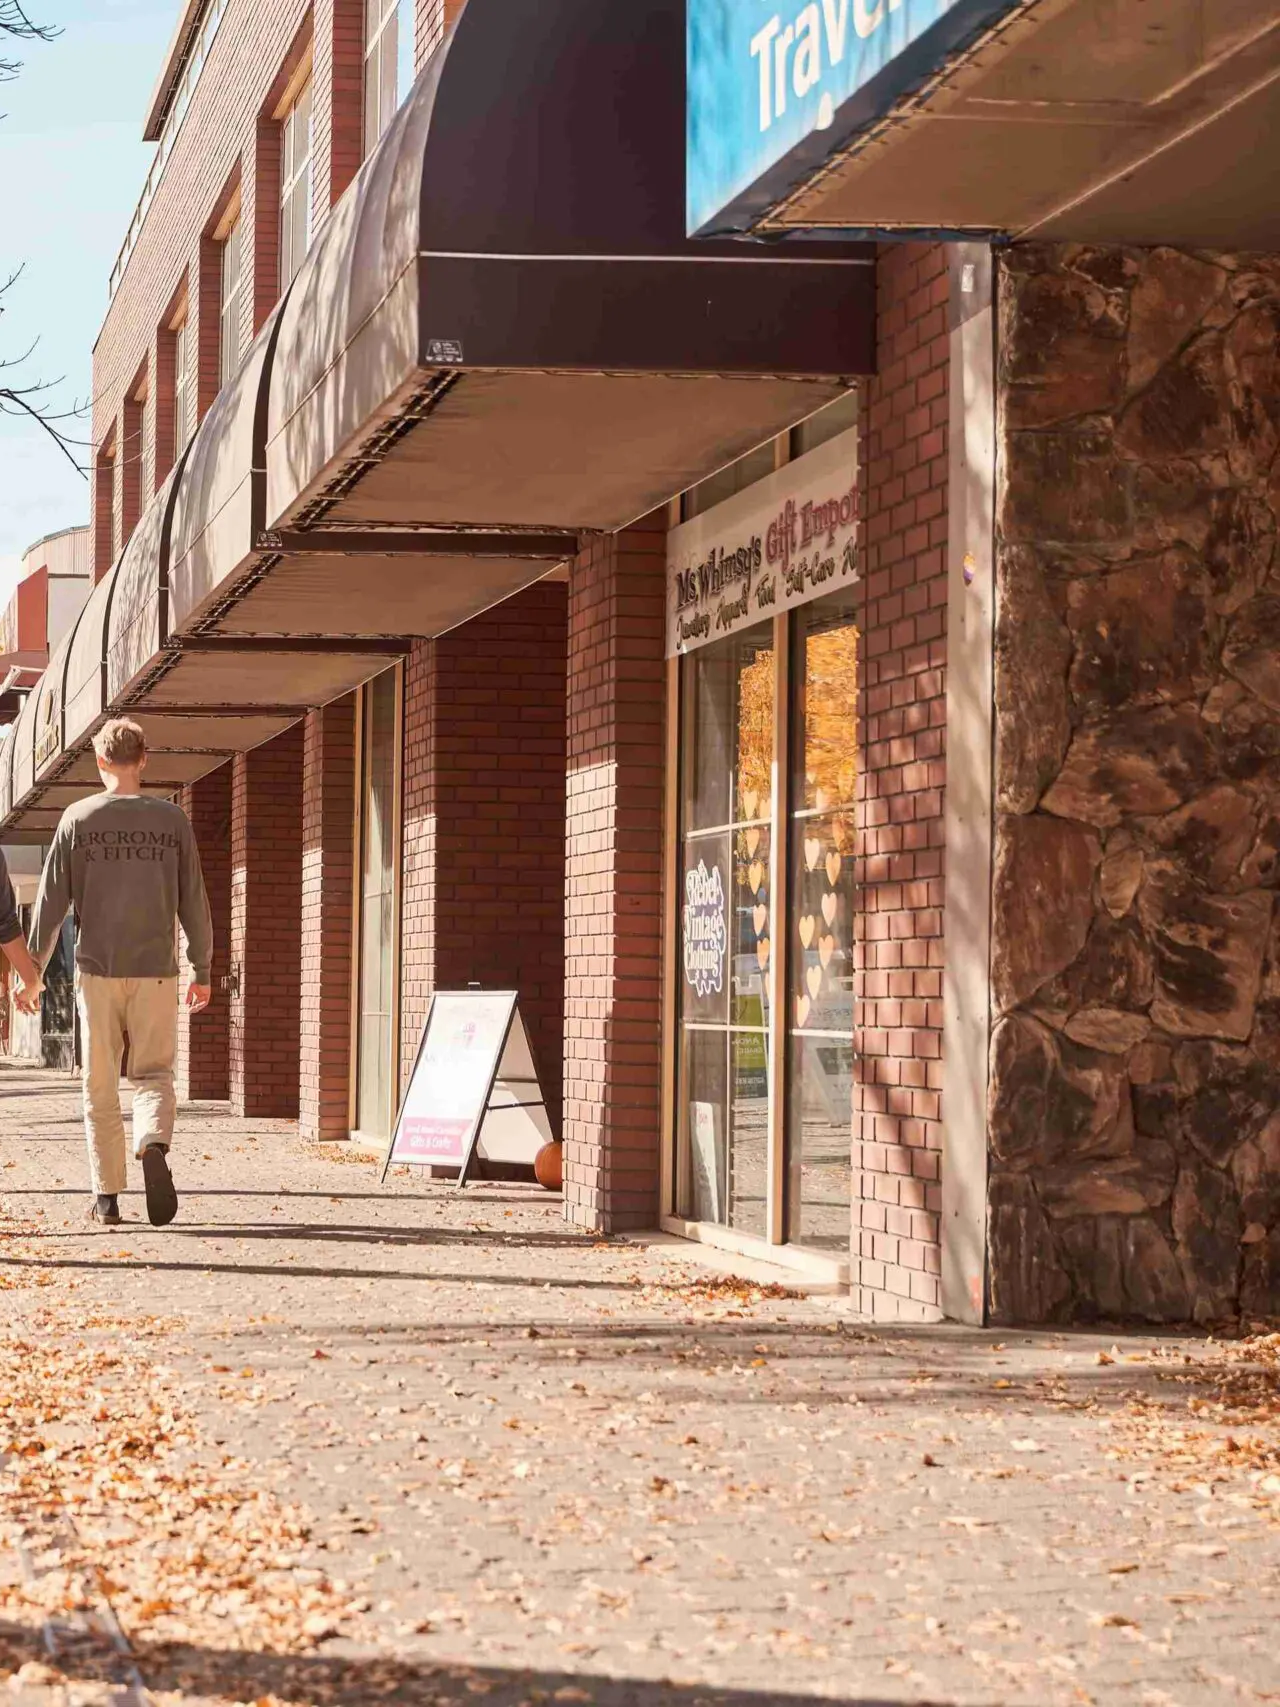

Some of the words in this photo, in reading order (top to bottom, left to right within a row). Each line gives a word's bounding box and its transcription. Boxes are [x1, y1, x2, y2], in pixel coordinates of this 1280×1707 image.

[676, 567, 699, 611] Ms.
[698, 536, 762, 600] Whimsy's
[766, 499, 797, 575] Gift
[85, 849, 97, 862] &
[104, 846, 166, 862] FITCH
[684, 905, 724, 950] Vintage
[685, 941, 719, 977] Clothing
